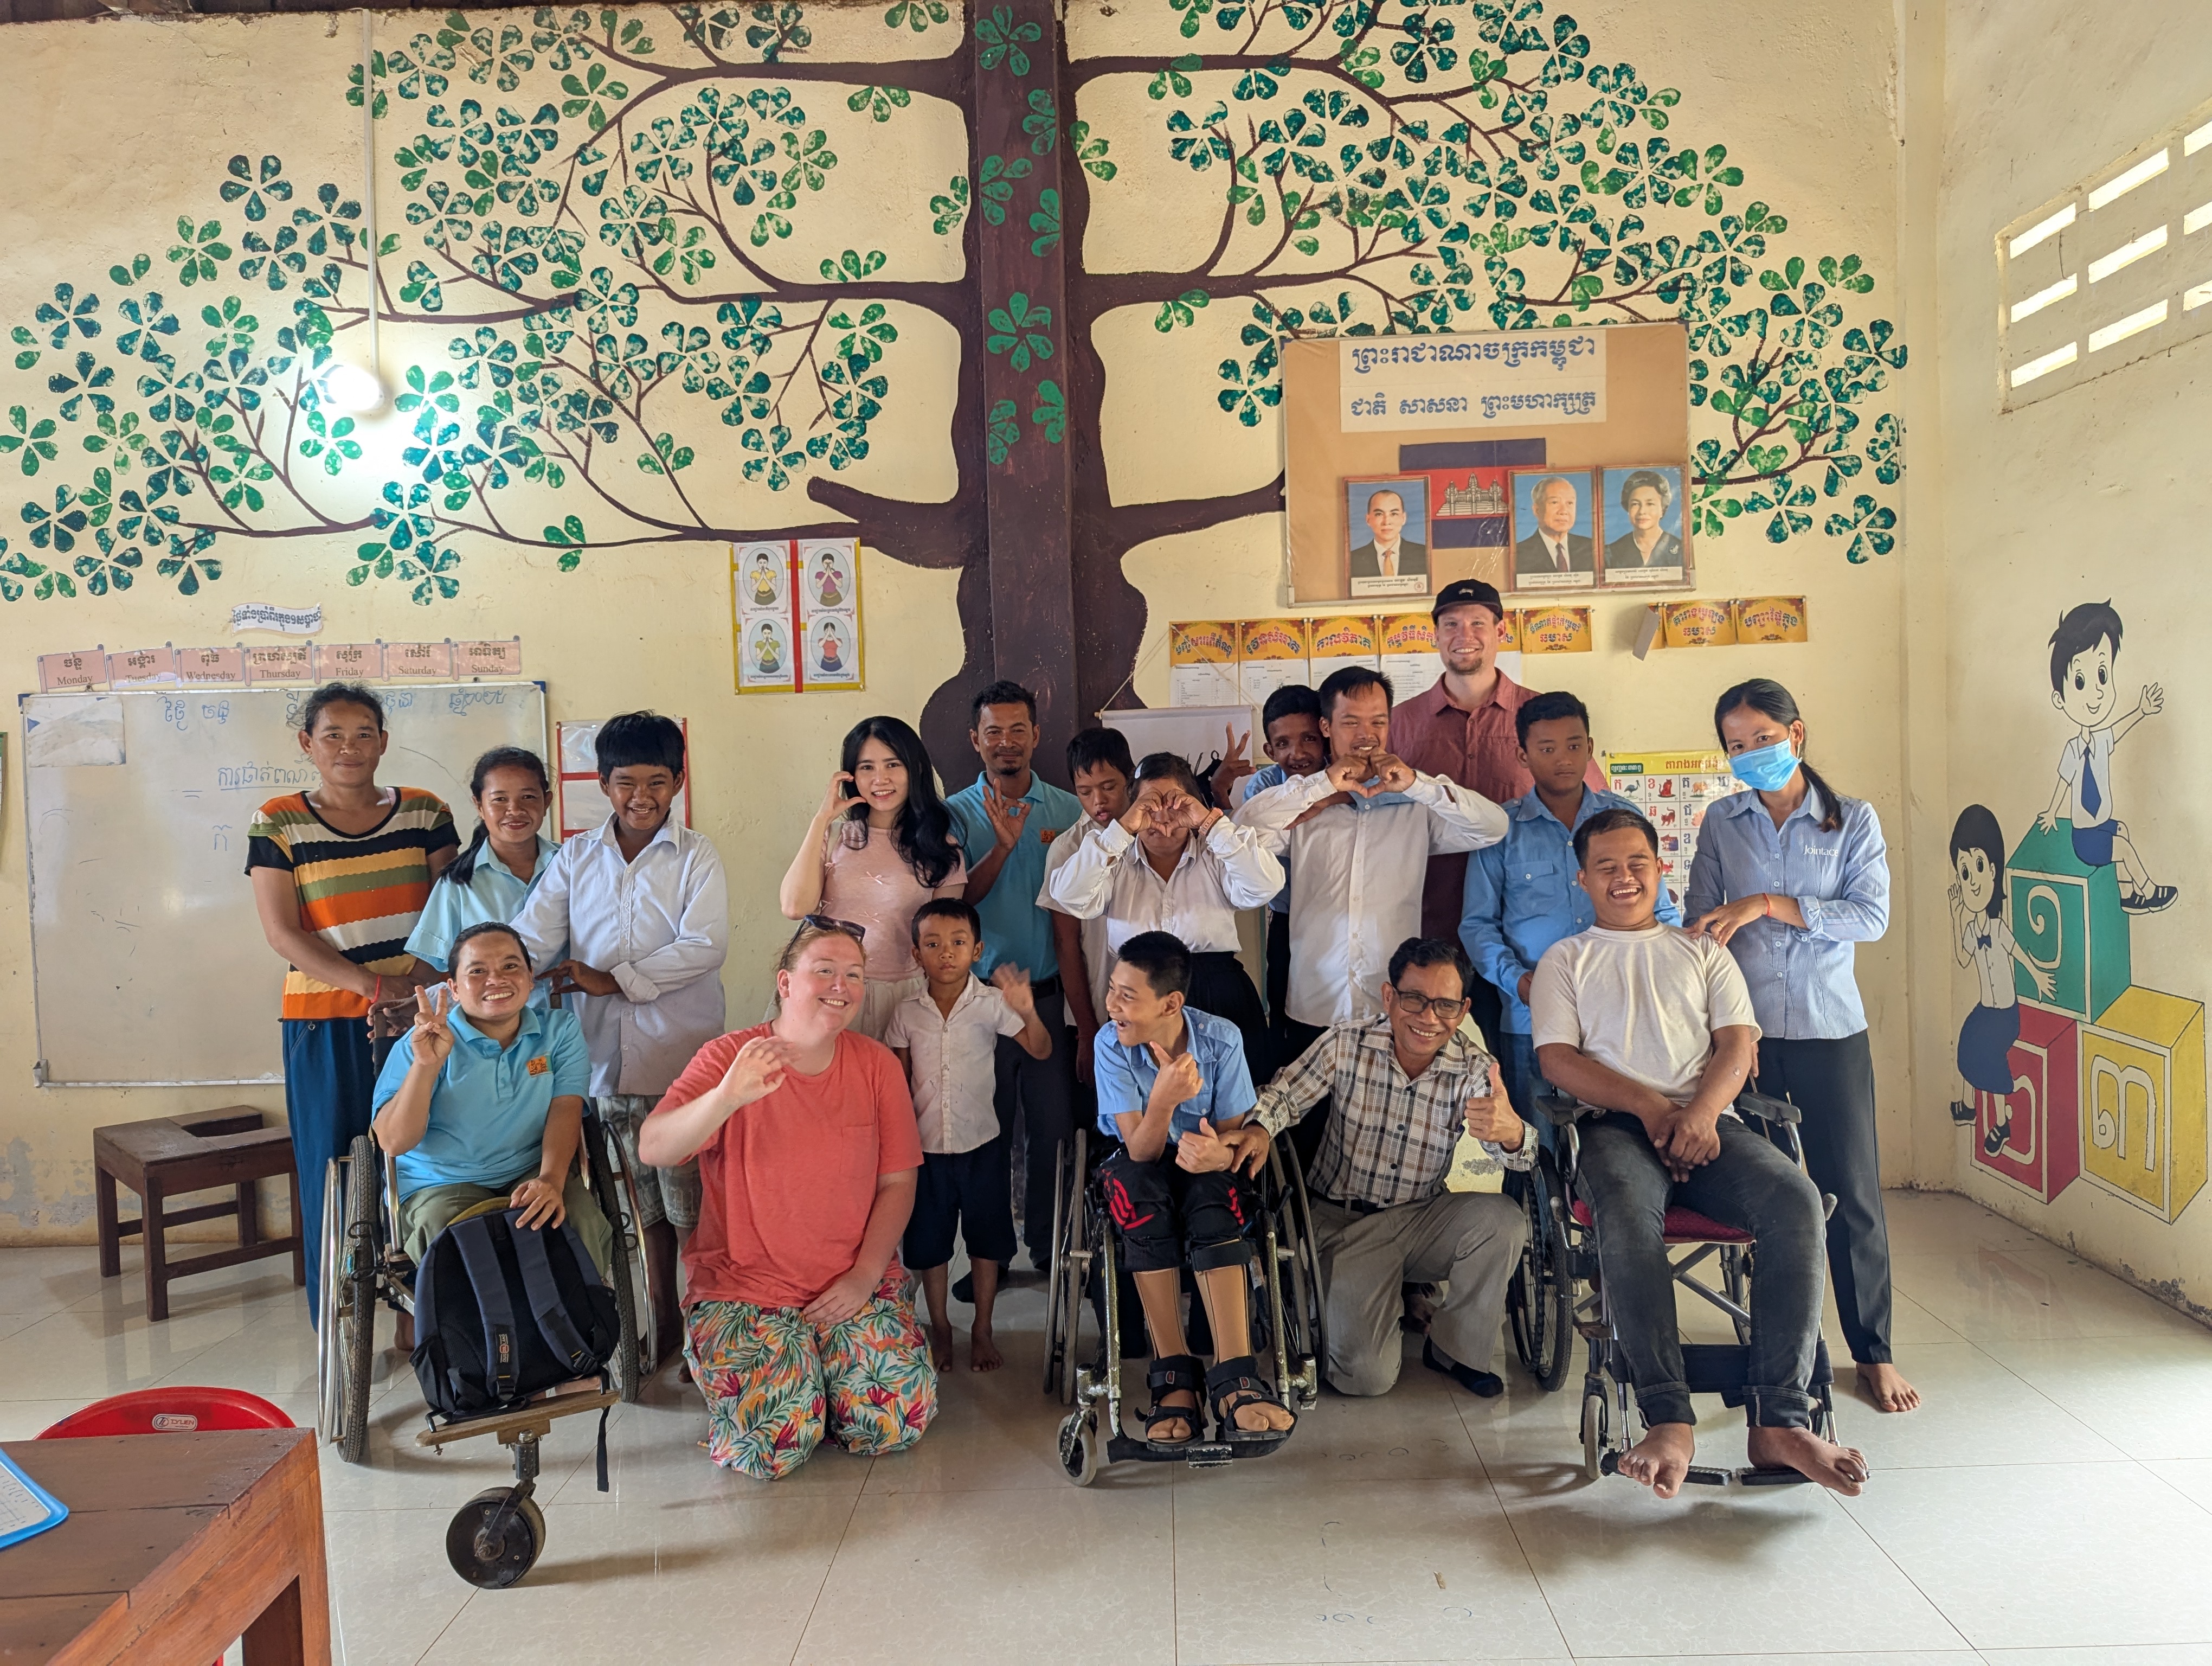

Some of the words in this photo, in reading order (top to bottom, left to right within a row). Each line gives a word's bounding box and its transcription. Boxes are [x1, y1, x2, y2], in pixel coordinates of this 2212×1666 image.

[1352, 335, 1595, 374] ព្រះរាជាណាចក្រកម្ពុជា
[1351, 392, 1387, 416] ជាតិ
[1399, 396, 1468, 415] សាសនា
[1481, 392, 1596, 419] ព្រះមហាក្សត្រ
[1386, 624, 1438, 649] កម្មវិធីសិក្ស
[1682, 626, 1716, 636] ឆមាស
[1316, 626, 1372, 652] កាលវិភាគ
[1539, 633, 1573, 643] ឆមាស
[336, 649, 362, 663] សុក្រ
[470, 644, 506, 660] អាទិត្យ
[63, 657, 82, 670] ចន្ទ
[127, 655, 156, 669] អង្គារ
[201, 653, 220, 667] ពុធ
[186, 670, 236, 681] Wednesday
[259, 669, 301, 679] Thursday
[336, 667, 364, 678] Friday
[398, 665, 437, 676] Saturday
[471, 664, 504, 674] Sunday
[57, 674, 93, 685] Monday
[125, 672, 161, 683] Tuesday
[1613, 778, 1622, 790] ក
[1647, 778, 1656, 789] ខ
[1682, 777, 1690, 789] គ
[1648, 805, 1657, 817] ឆ
[1683, 804, 1692, 816] ជ
